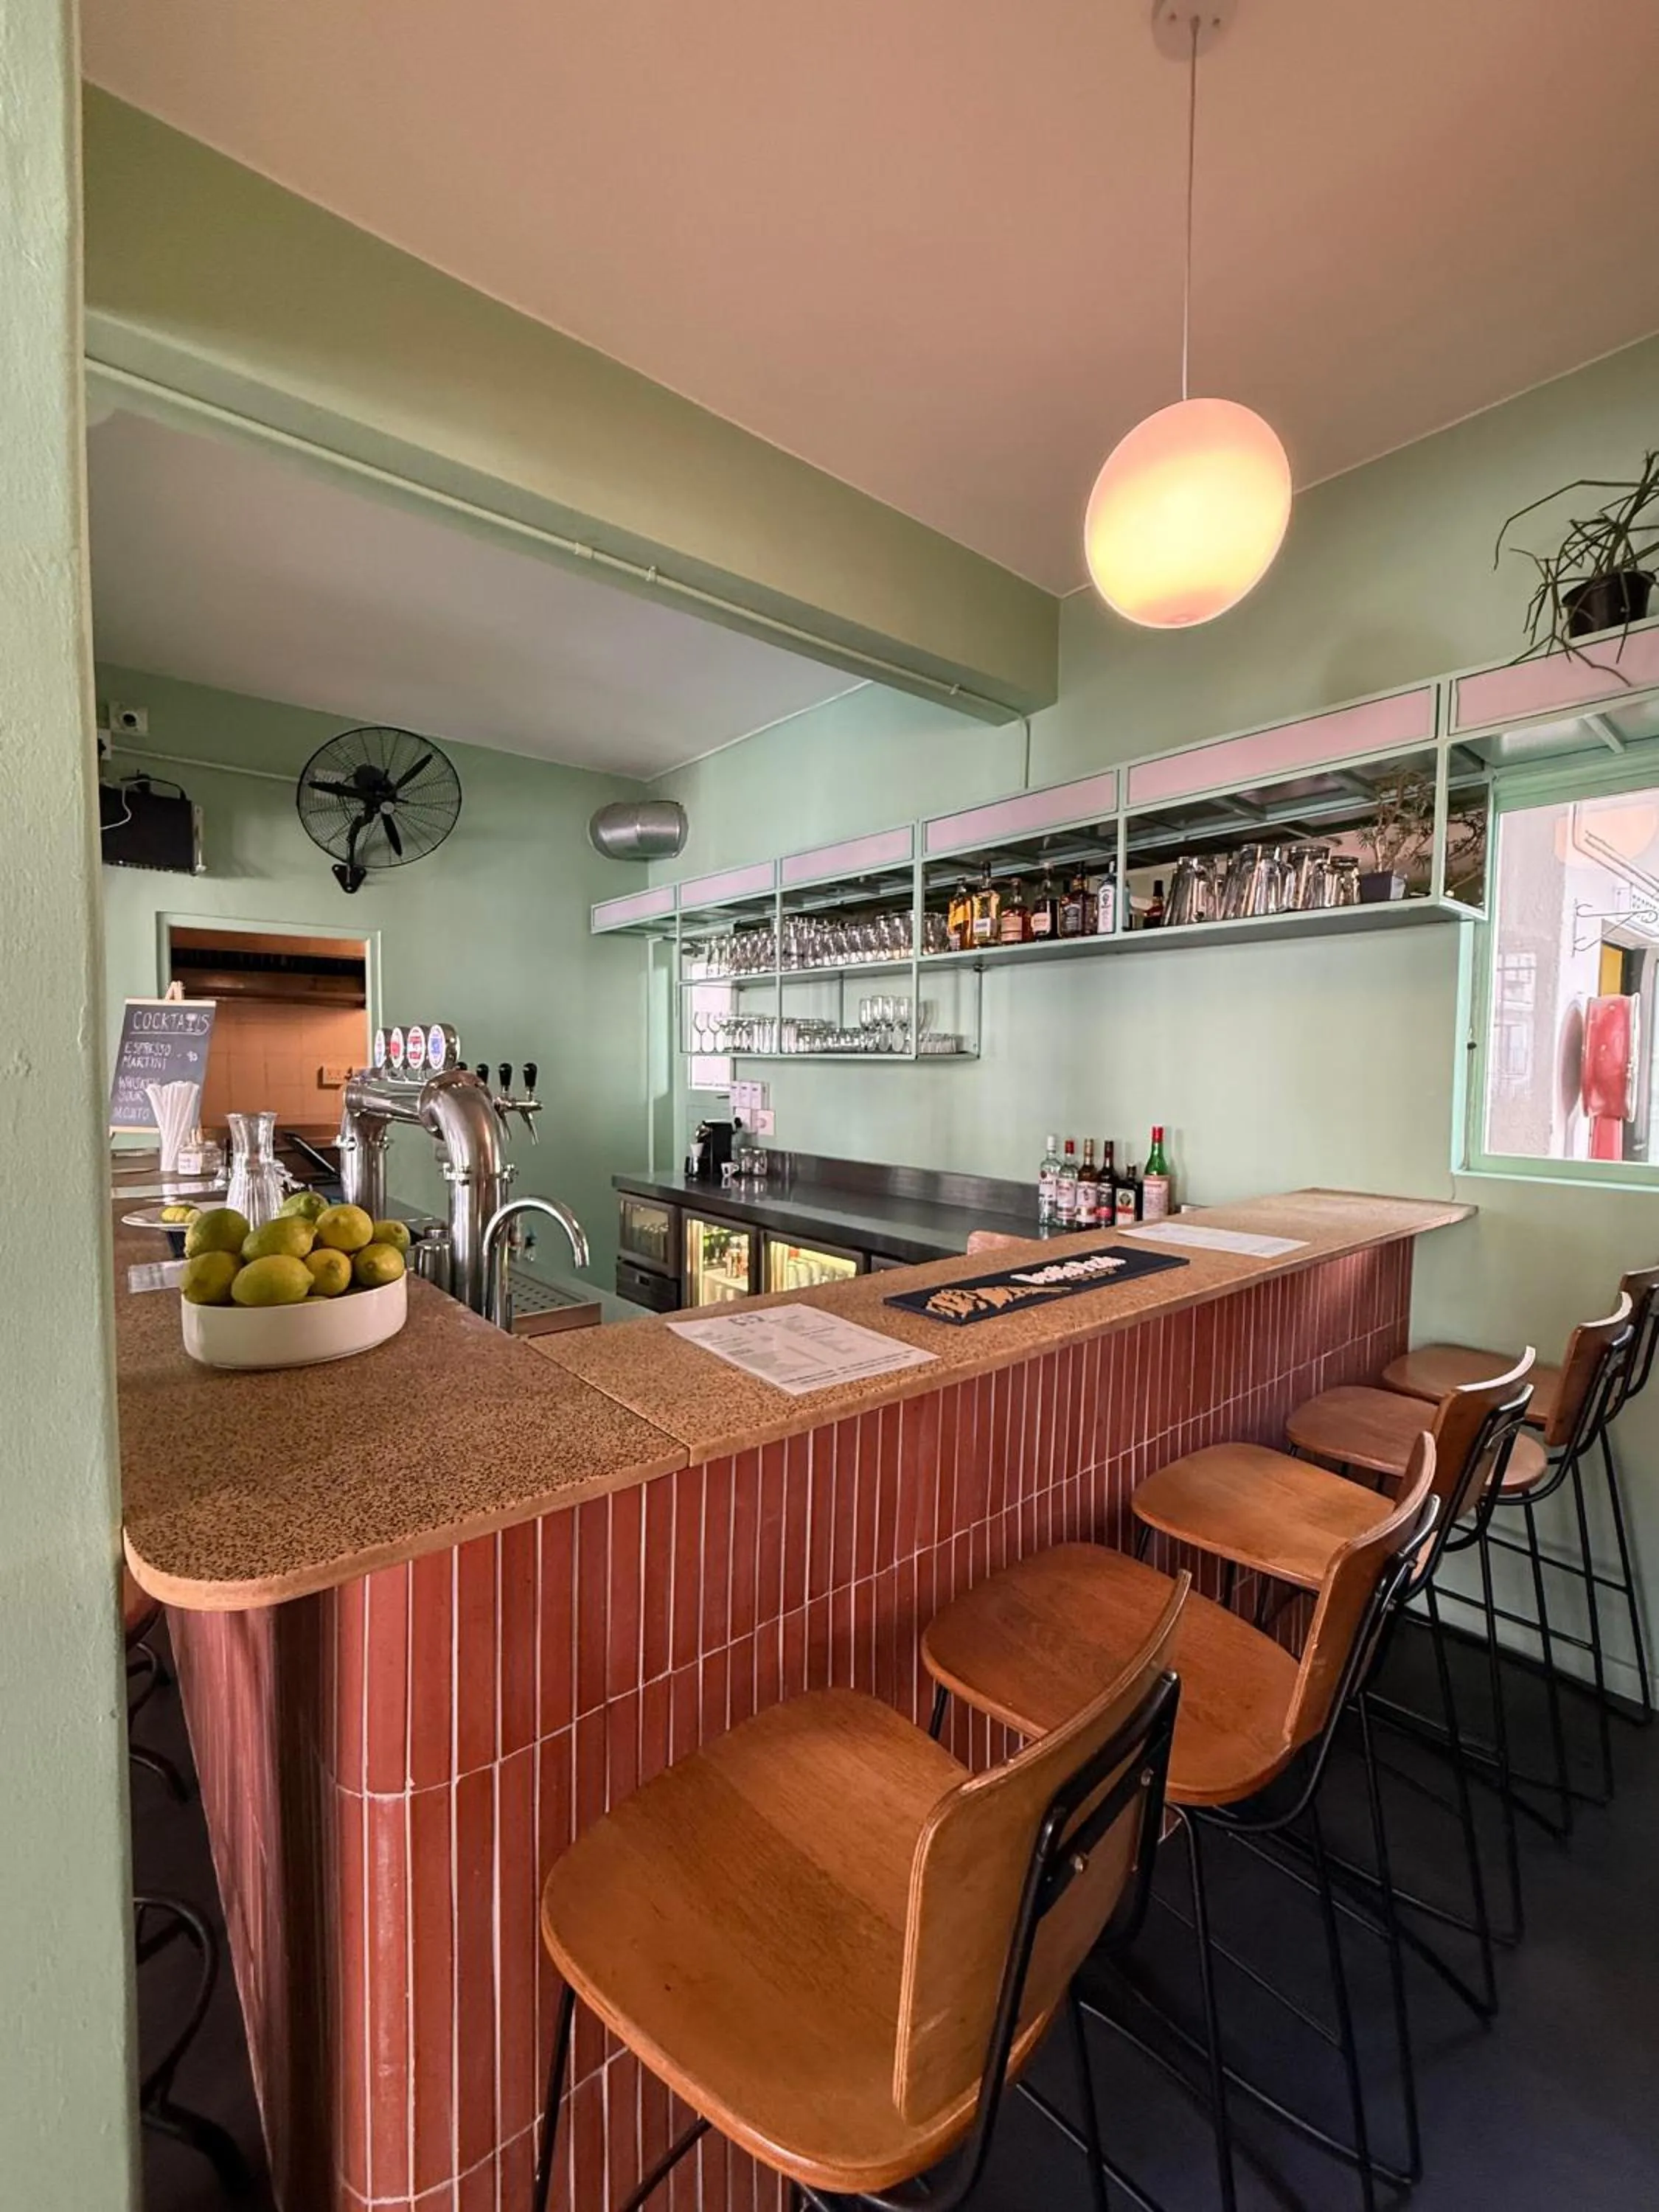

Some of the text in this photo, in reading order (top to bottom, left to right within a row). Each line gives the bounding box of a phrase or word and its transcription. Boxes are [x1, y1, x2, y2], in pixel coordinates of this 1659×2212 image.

[133, 1011, 211, 1034] COCKTAILS
[124, 1041, 172, 1056] ESPRESSO
[122, 1055, 167, 1071] MARTINI
